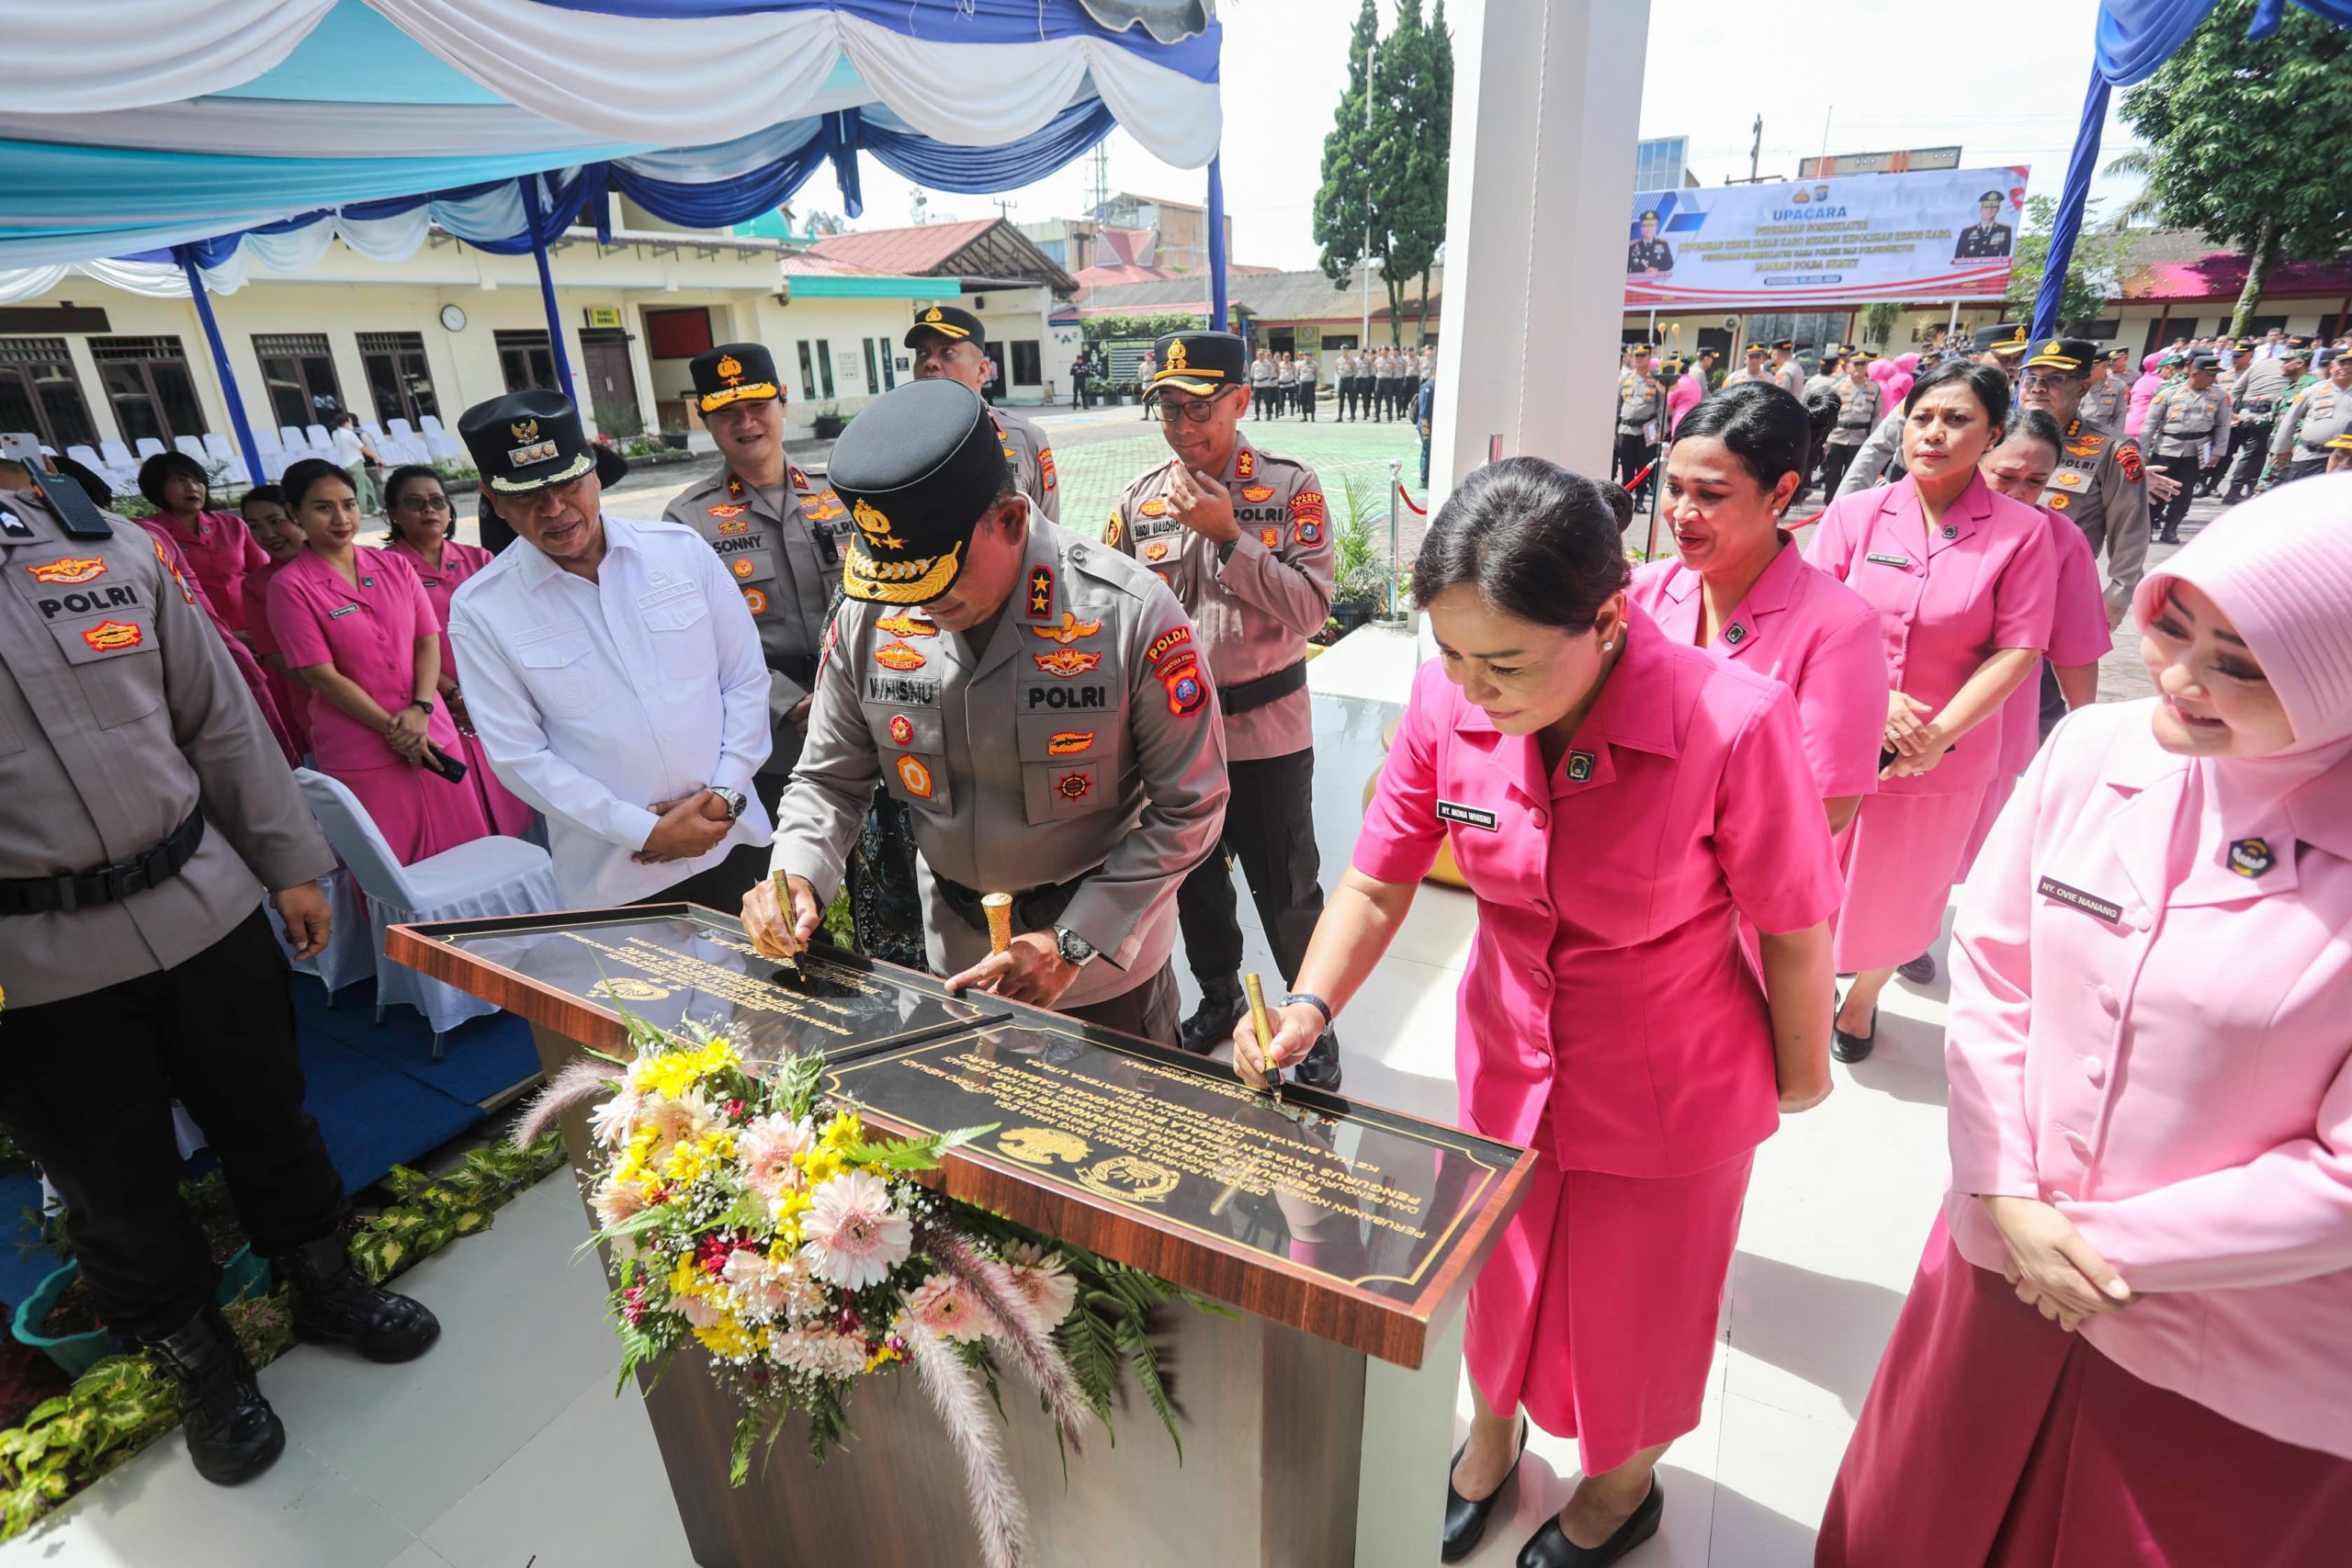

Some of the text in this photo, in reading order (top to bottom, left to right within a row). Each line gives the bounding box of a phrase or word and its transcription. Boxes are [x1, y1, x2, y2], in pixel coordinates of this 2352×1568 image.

[1773, 207, 1848, 220] UPACARA
[713, 536, 761, 553] SONNY
[38, 585, 139, 619] POLRI
[1148, 628, 1189, 660] POLDA
[869, 678, 933, 705] WHISNU
[1028, 686, 1106, 709] POLRI
[1468, 812, 1492, 825] WHISNU
[2041, 882, 2118, 919] NY. OVIE NANANG
[612, 945, 667, 961] KARO
[651, 959, 716, 978] RESOR
[703, 977, 807, 1010] KEPOLISIAN
[802, 998, 854, 1014] KEPALA
[785, 1011, 855, 1035] PERUBAHAN
[896, 1058, 951, 1077] MENJADI
[938, 1055, 991, 1074] MENJADI
[1119, 1059, 1204, 1087] HERMAWAN
[942, 1074, 981, 1088] KARO
[984, 1070, 1022, 1084] KARO
[1015, 1080, 1058, 1096] TANAH
[1186, 1074, 1222, 1086] APRIL
[974, 1085, 1018, 1100] TANAH
[1052, 1093, 1108, 1112] CABANG
[988, 1099, 1023, 1111] ESA
[1012, 1097, 1100, 1128] BHAYANGKARI
[1015, 1108, 1060, 1124] MAHA
[1021, 1058, 1381, 1173] KETUA BHAYANGKARI DAERAH SUMATERA UTARA
[1114, 1094, 1246, 1138] DIRESMIKAN OLEH
[956, 1053, 1422, 1204] PENGURUS YAYASAN KEMALA BHAYANGKARI CABANG KARO
[1053, 1121, 1097, 1137] YANG
[1093, 1124, 1152, 1146] CABANG
[1102, 1109, 1193, 1140] BHAYANGKARI
[987, 1080, 1323, 1193] PENGURUS CABANG BHAYANGKARI KARO
[1091, 1134, 1144, 1153] TUHAN
[1187, 1136, 1245, 1157] KEMALA
[1140, 1149, 1205, 1174] RAHMAT
[1147, 1143, 1226, 1171] PENGURUS
[1241, 1154, 1306, 1177] YAYASAN
[1201, 1169, 1270, 1196] DENGAN
[1224, 1168, 1332, 1207] NOMENKLATUR
[1304, 1173, 1386, 1203] PENGURUS
[1385, 1199, 1419, 1214] DAN
[1331, 1202, 1428, 1239] PERUBAHAN
